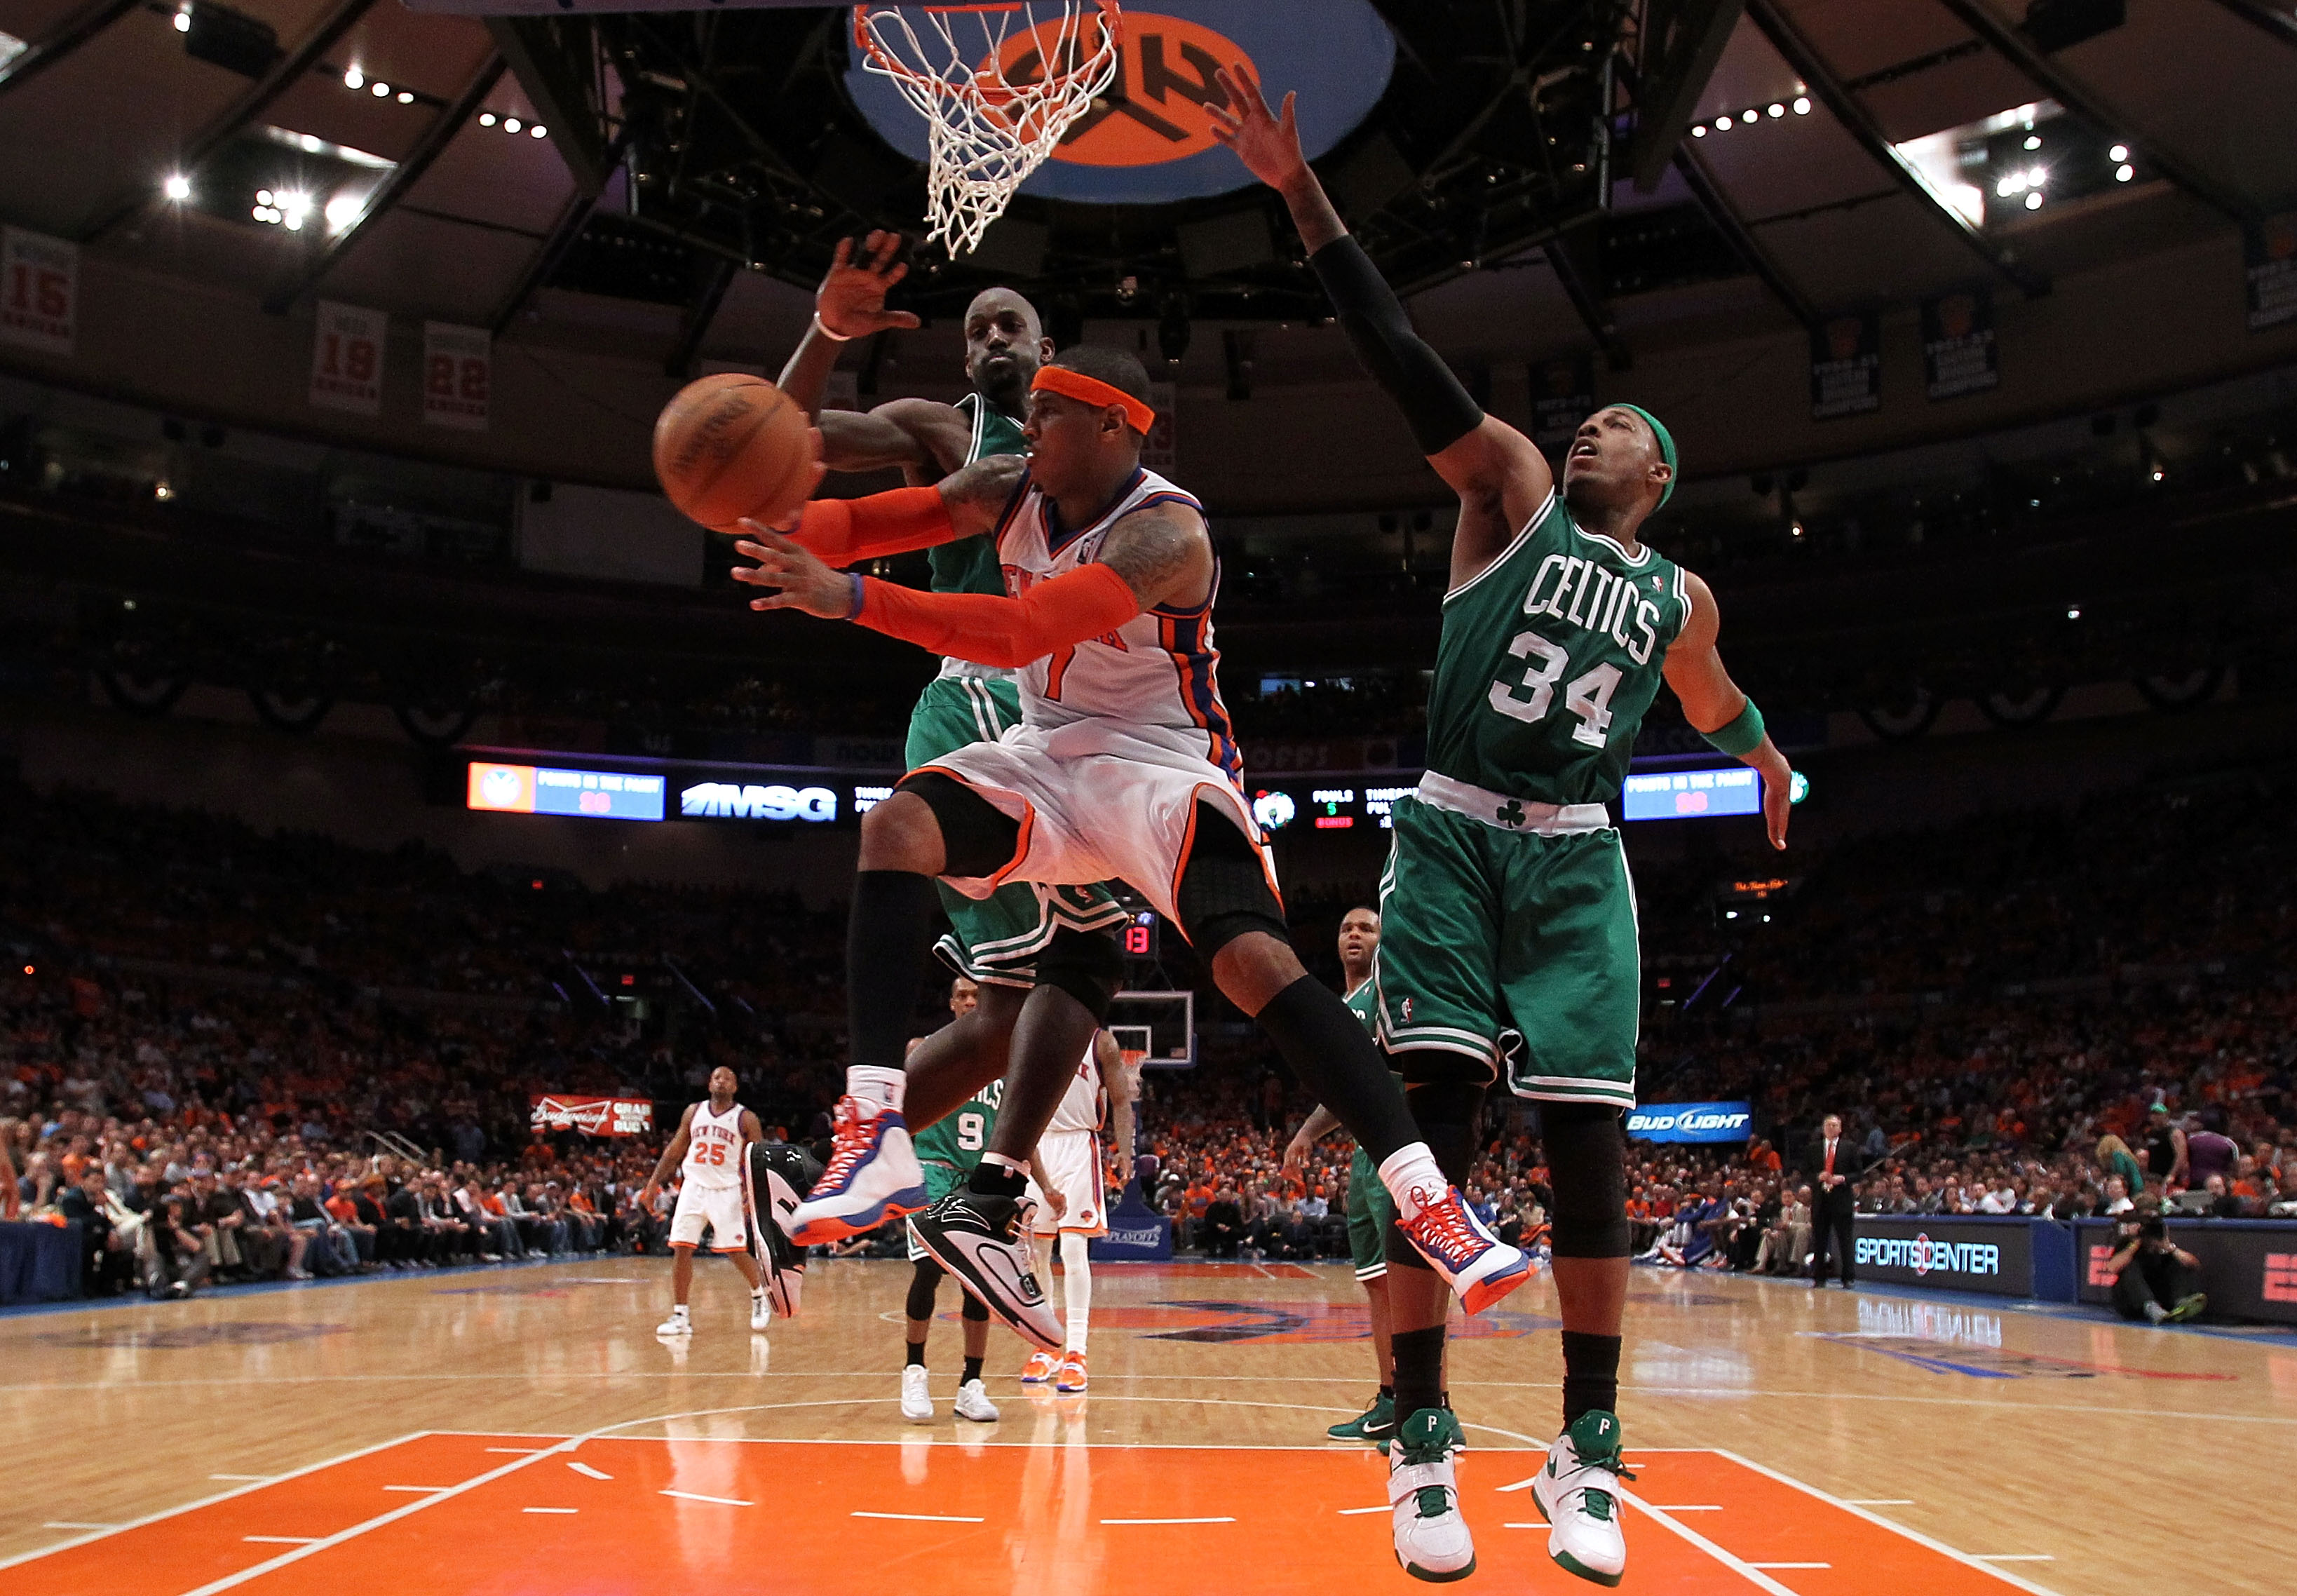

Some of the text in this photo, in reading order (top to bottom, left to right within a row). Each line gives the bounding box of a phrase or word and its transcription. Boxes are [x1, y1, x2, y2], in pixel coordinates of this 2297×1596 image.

[1524, 553, 1660, 665] CELTICS
[1488, 631, 1622, 749] 34
[691, 783, 836, 821] MSG
[1313, 790, 1354, 802] FOULS
[1317, 818, 1353, 827] BONUS
[1125, 926, 1149, 954] 13
[958, 1113, 984, 1151] 9
[1627, 1114, 1749, 1131] BUD LIGHT
[695, 1142, 725, 1166] 25
[1855, 1237, 1998, 1276] SPORTSCENTER
